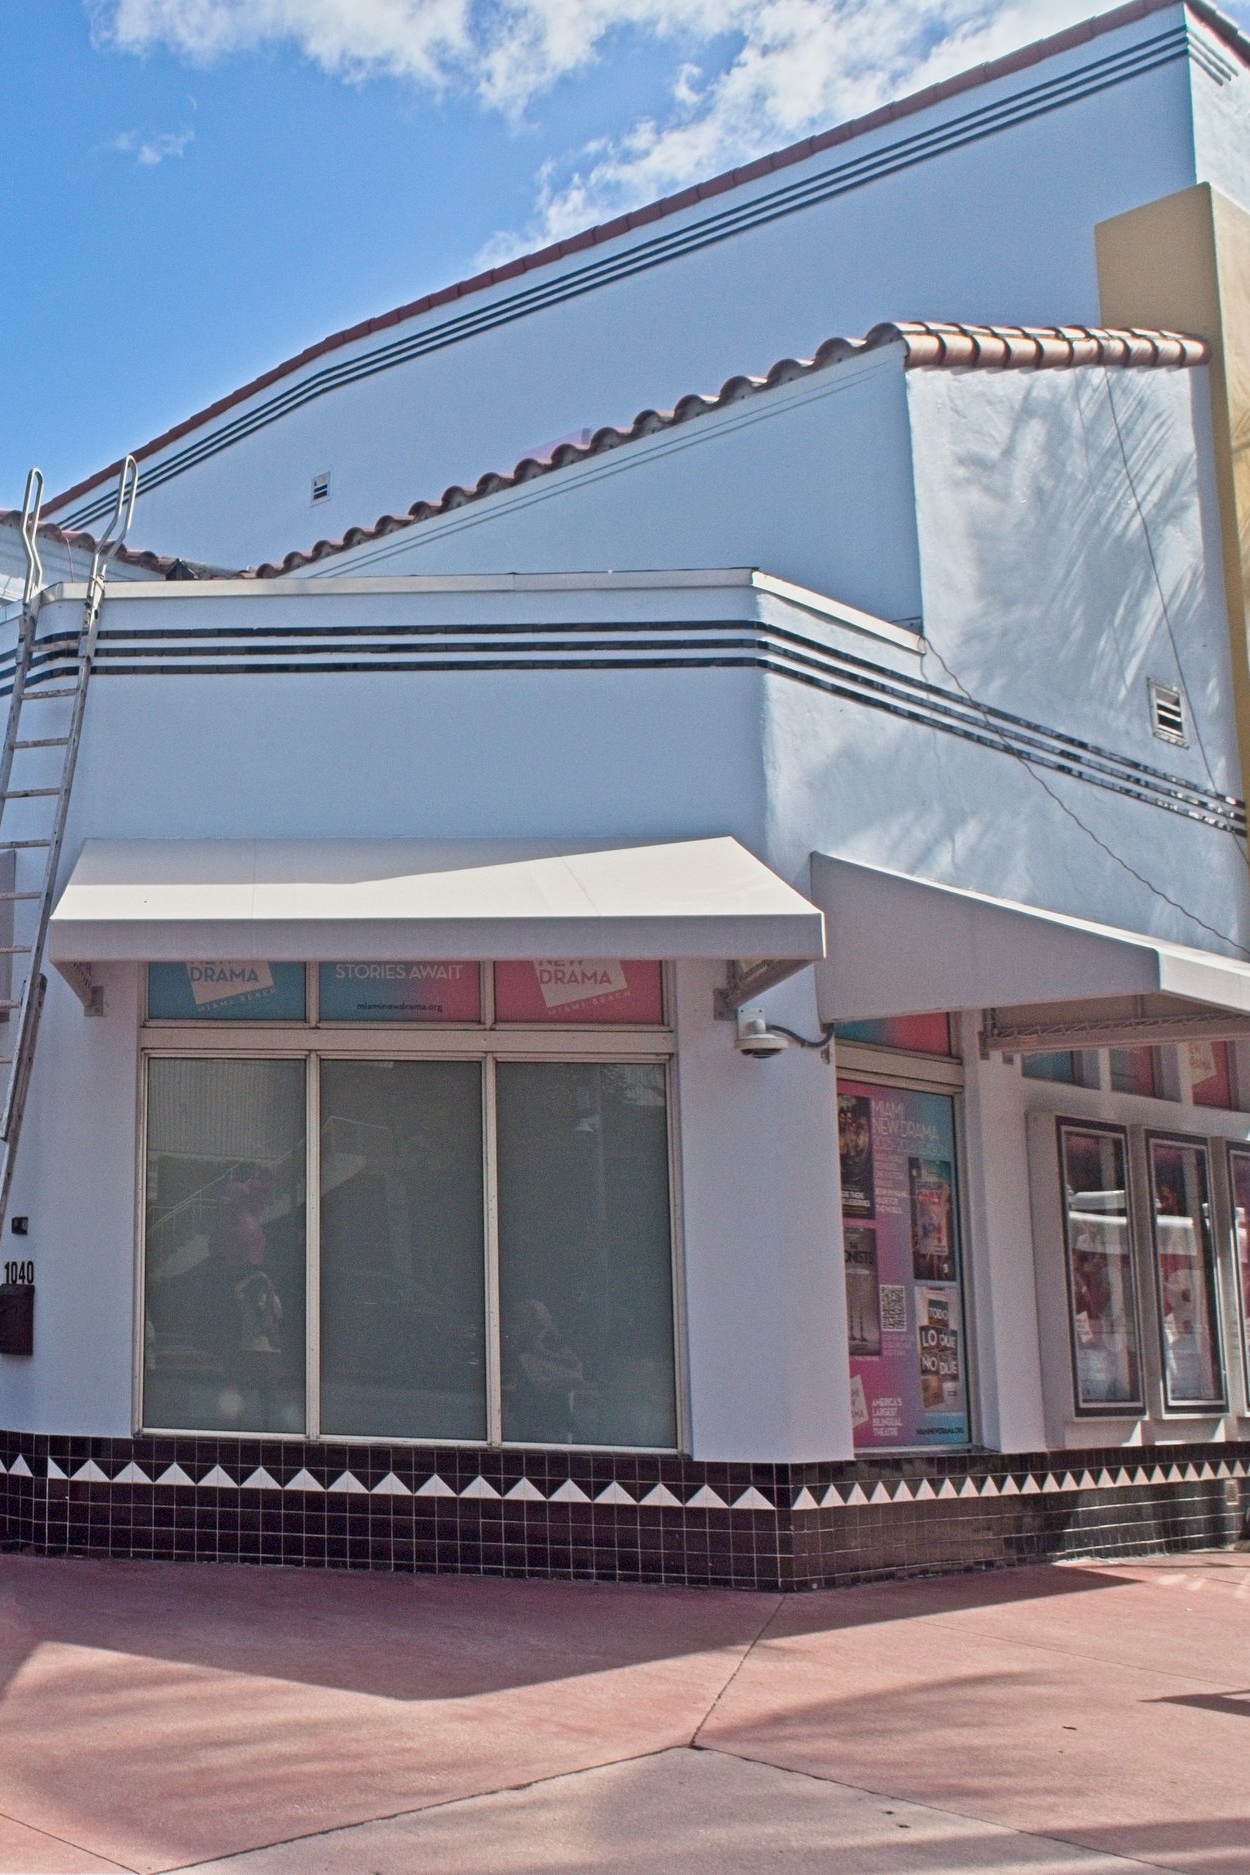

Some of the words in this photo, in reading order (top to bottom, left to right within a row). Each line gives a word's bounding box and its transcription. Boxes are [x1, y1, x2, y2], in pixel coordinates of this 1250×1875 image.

[190, 966, 259, 982] DRAMA
[336, 964, 406, 979] STORIES
[409, 964, 463, 979] AWAIT
[539, 969, 611, 985] DRAMA
[357, 1001, 443, 1013] miaminewdrama.org
[872, 1099, 905, 1118] MIAMI
[872, 1116, 900, 1136] NEW
[901, 1120, 939, 1140] DRAMA
[4, 1260, 35, 1284] 1040
[928, 1307, 949, 1320] TODO
[921, 1329, 938, 1348] LO
[939, 1334, 957, 1349] QUE
[921, 1356, 938, 1372] NO
